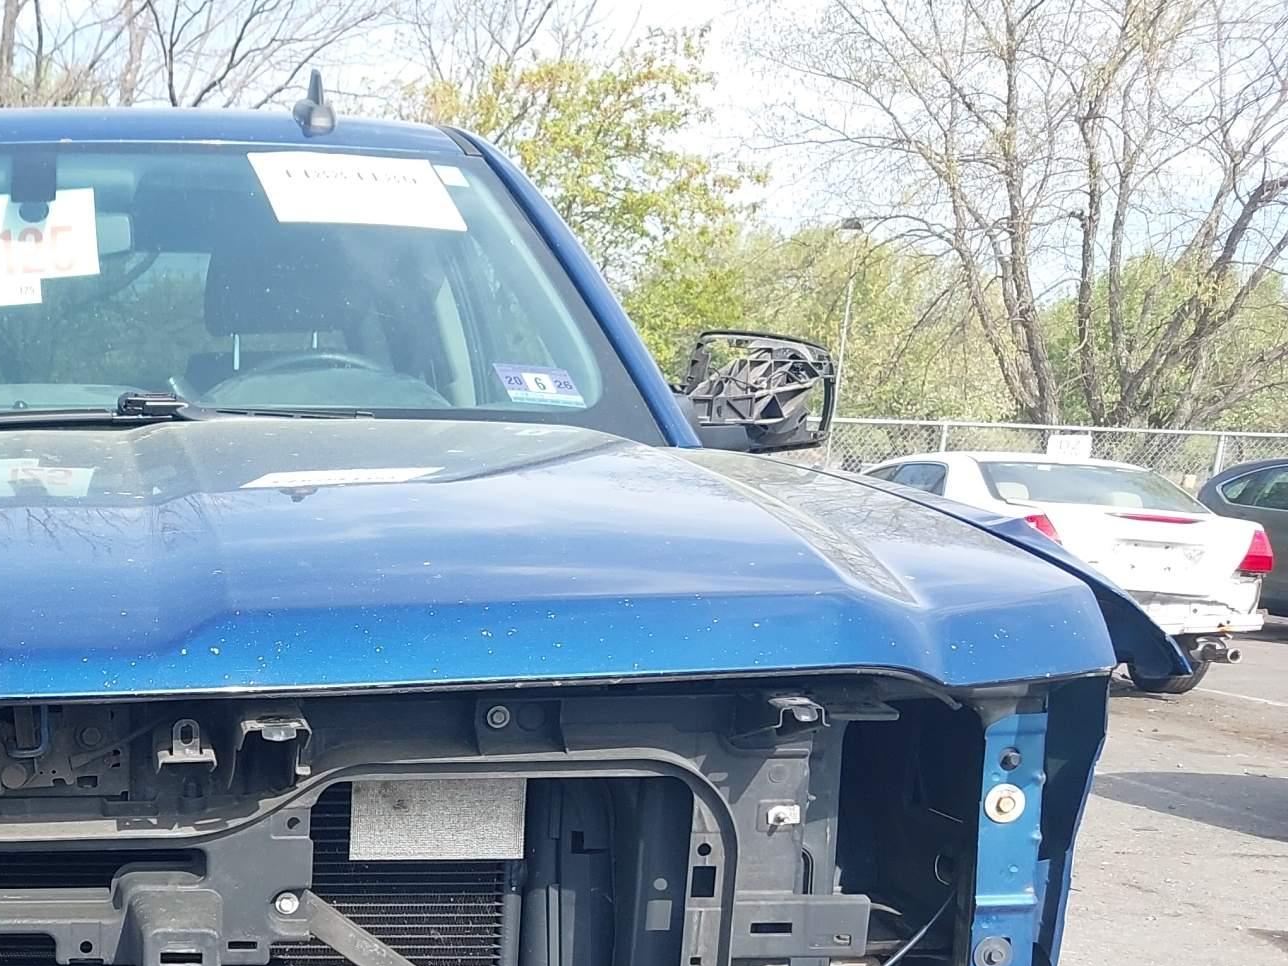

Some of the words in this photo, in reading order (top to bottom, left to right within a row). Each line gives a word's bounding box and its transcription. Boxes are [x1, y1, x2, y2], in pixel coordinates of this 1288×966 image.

[505, 375, 523, 386] 20
[534, 377, 547, 391] 6
[554, 380, 573, 390] 26
